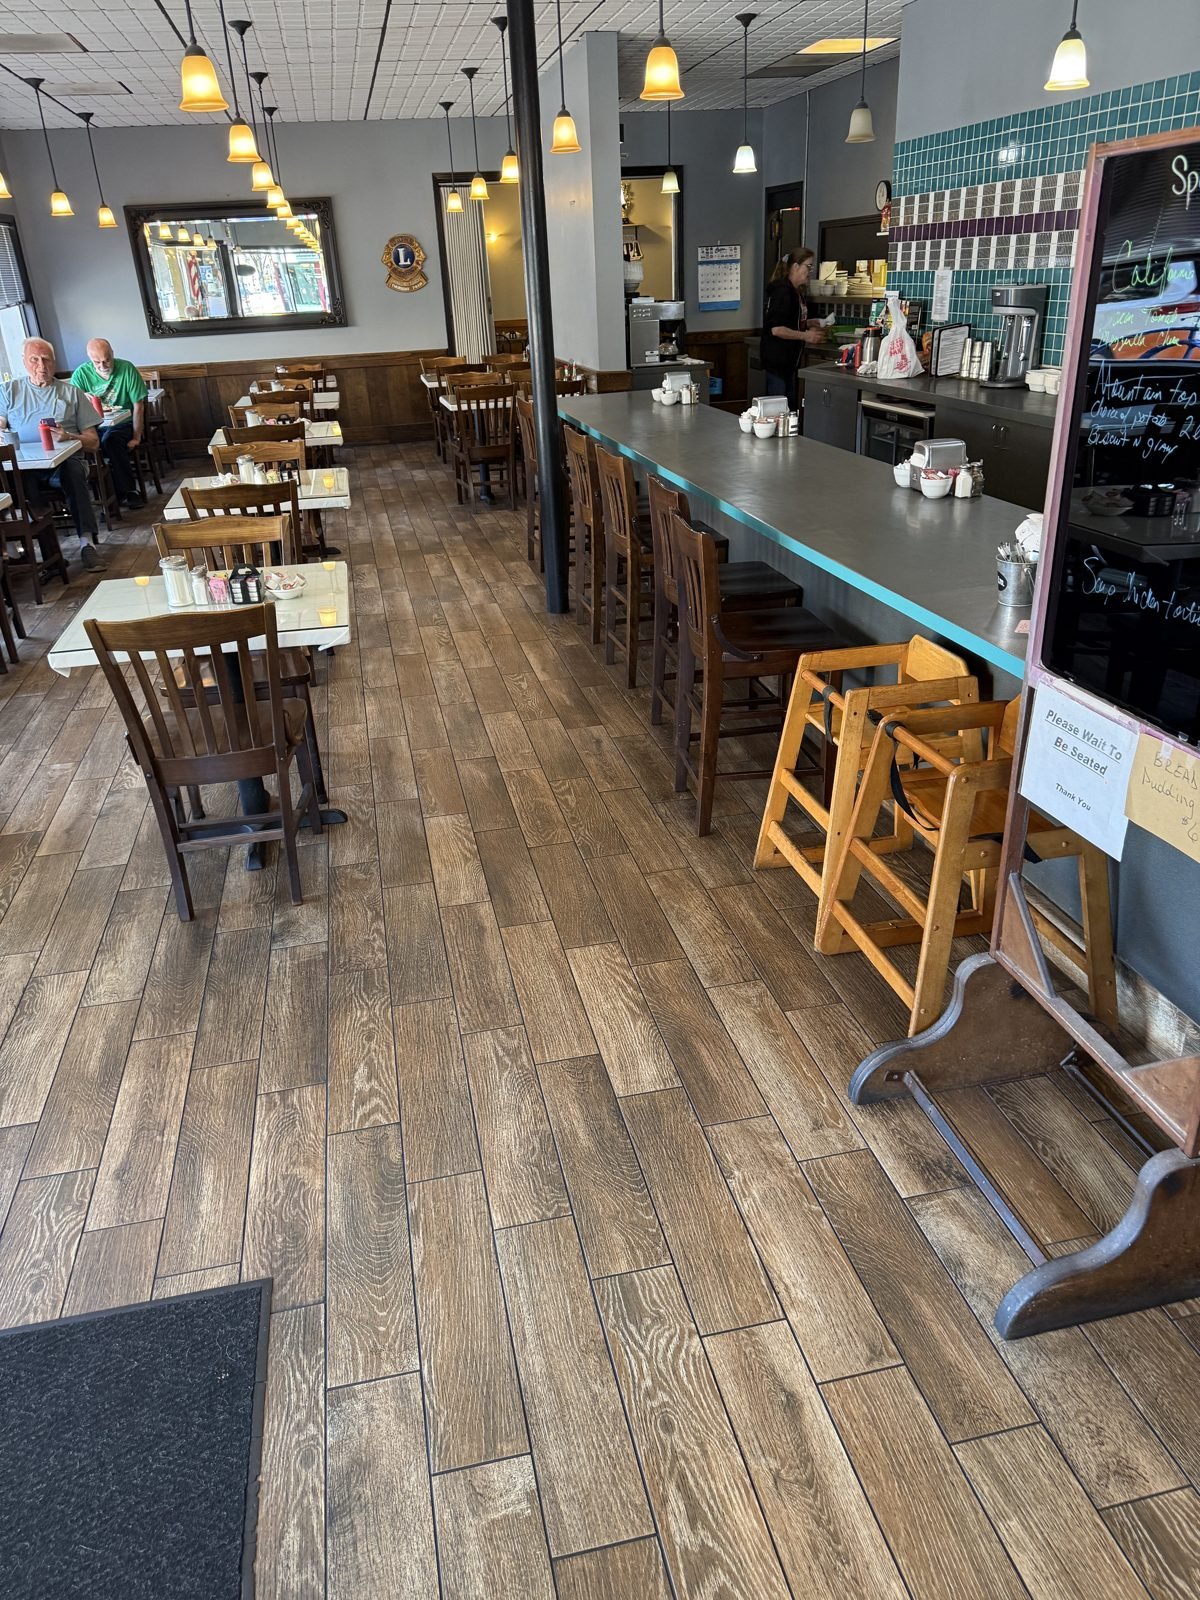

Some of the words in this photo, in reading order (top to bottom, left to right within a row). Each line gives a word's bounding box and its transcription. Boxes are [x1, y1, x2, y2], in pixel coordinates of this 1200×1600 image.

[397, 248, 411, 265] L
[1045, 709, 1080, 736] Please
[1082, 729, 1107, 752] Wait
[1109, 744, 1122, 760] To
[1053, 736, 1068, 751] Be
[1070, 746, 1108, 775] Seated
[1055, 782, 1075, 801] Thank
[1078, 797, 1091, 811] You
